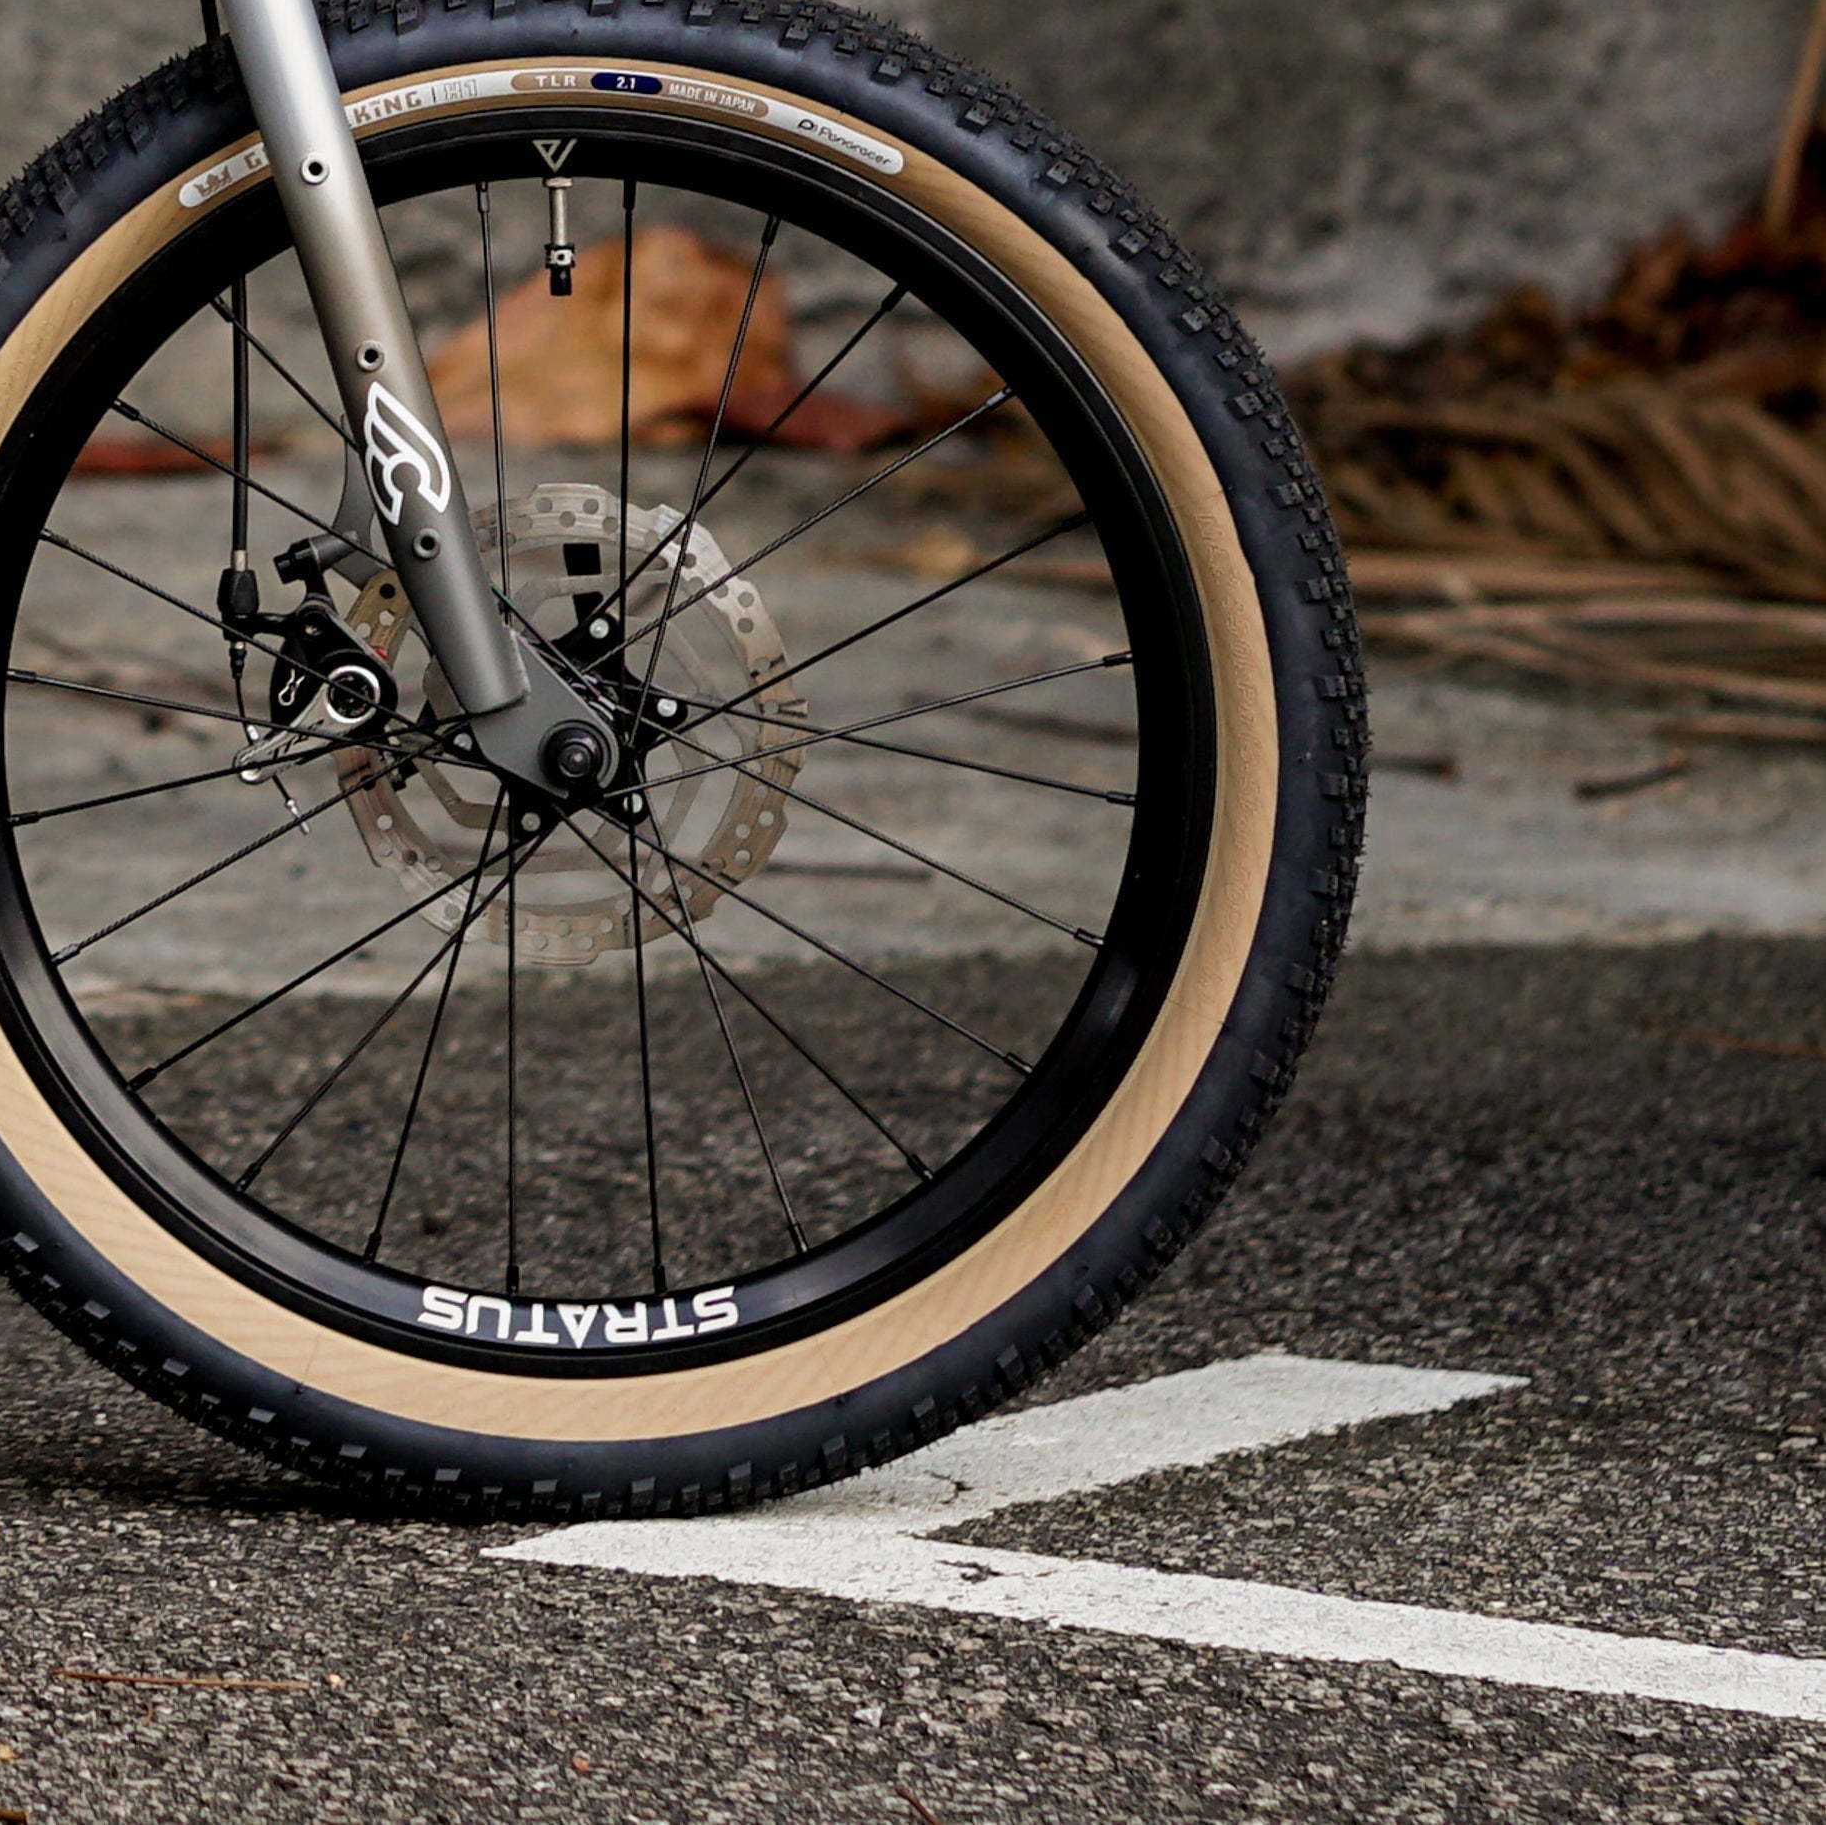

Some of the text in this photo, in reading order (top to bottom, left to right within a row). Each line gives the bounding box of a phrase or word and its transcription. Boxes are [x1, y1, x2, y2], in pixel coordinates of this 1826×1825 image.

[535, 75, 577, 88] TLR
[616, 76, 636, 90] 2.1
[668, 83, 756, 113] MADE IN JAPAN
[818, 126, 892, 165] Panaracer
[417, 1284, 740, 1349] STRATUS
